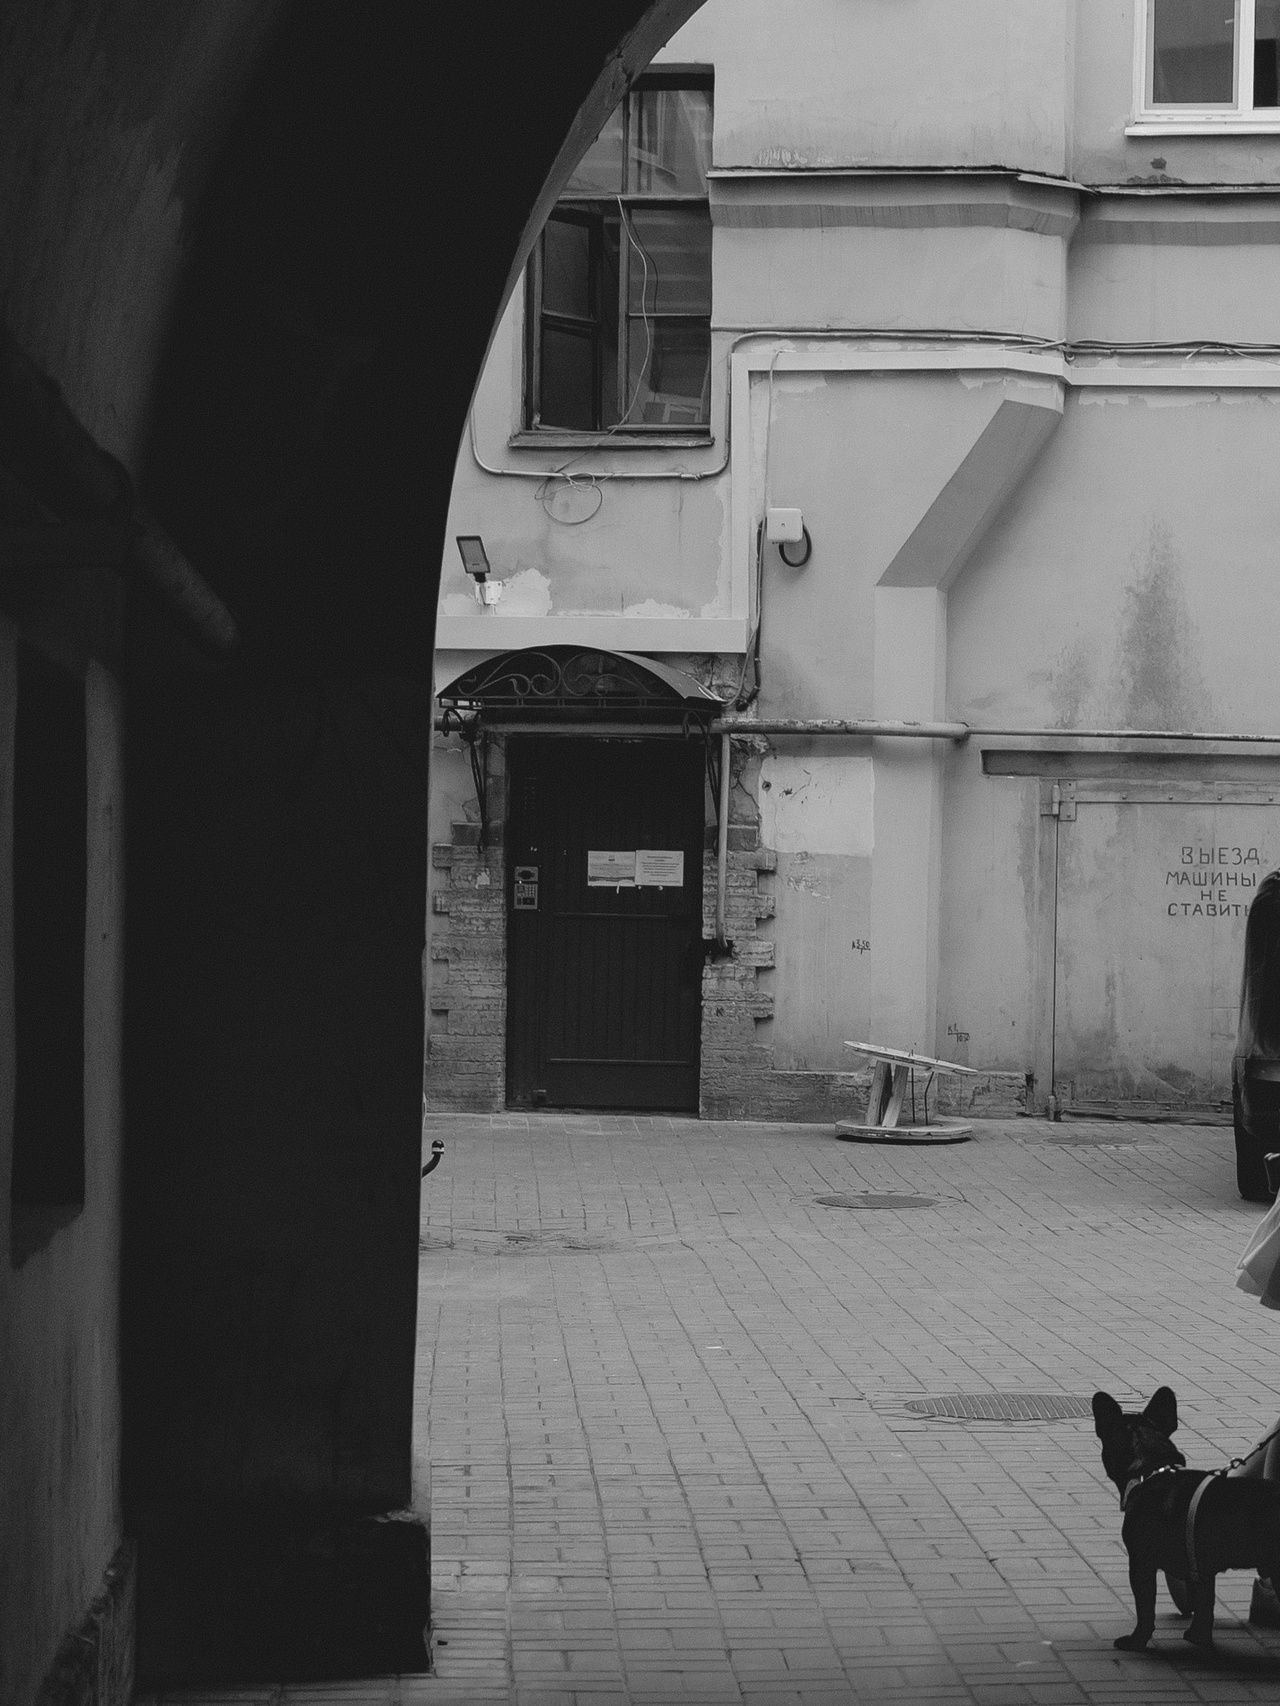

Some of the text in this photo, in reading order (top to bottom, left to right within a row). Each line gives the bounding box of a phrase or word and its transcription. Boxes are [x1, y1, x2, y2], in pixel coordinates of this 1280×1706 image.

[1181, 846, 1260, 865] ВЫЕЗД
[1165, 871, 1256, 887] МАШИНЫ
[1200, 889, 1227, 902] НЕ
